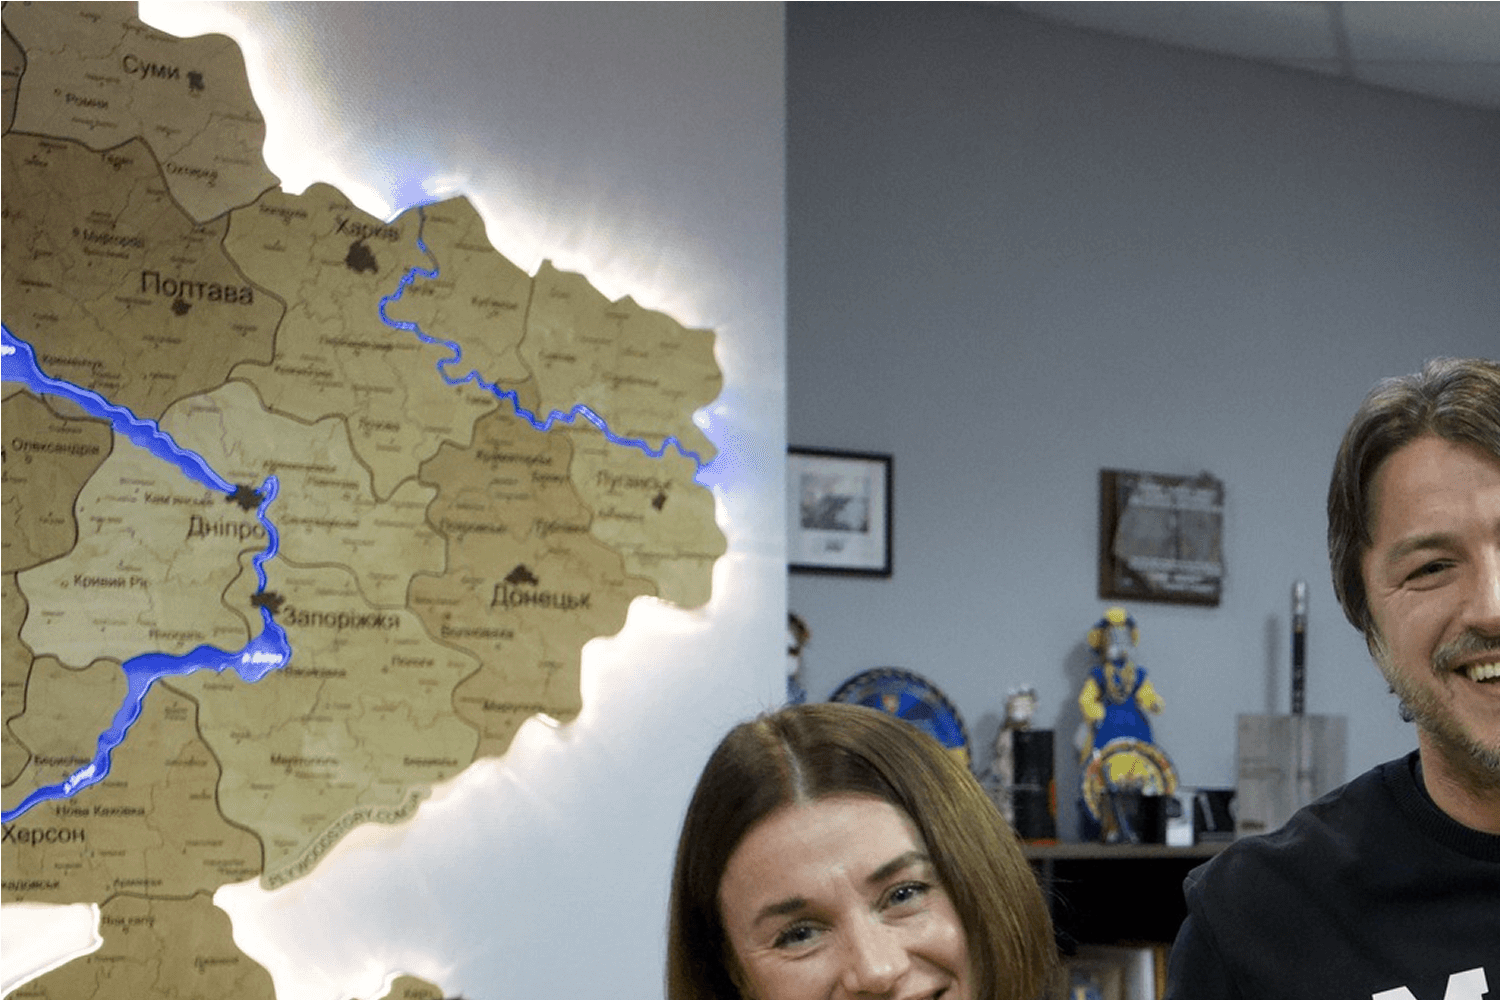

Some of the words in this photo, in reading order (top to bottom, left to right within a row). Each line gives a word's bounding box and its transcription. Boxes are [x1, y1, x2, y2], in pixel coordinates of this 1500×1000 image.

[122, 54, 181, 81] Суми
[140, 271, 255, 305] Полтава
[187, 514, 266, 545] Дніпро
[73, 573, 126, 590] Кривий
[490, 582, 591, 611] Донецьк
[283, 605, 400, 632] Запоріжжя
[1, 825, 85, 848] Херсон
